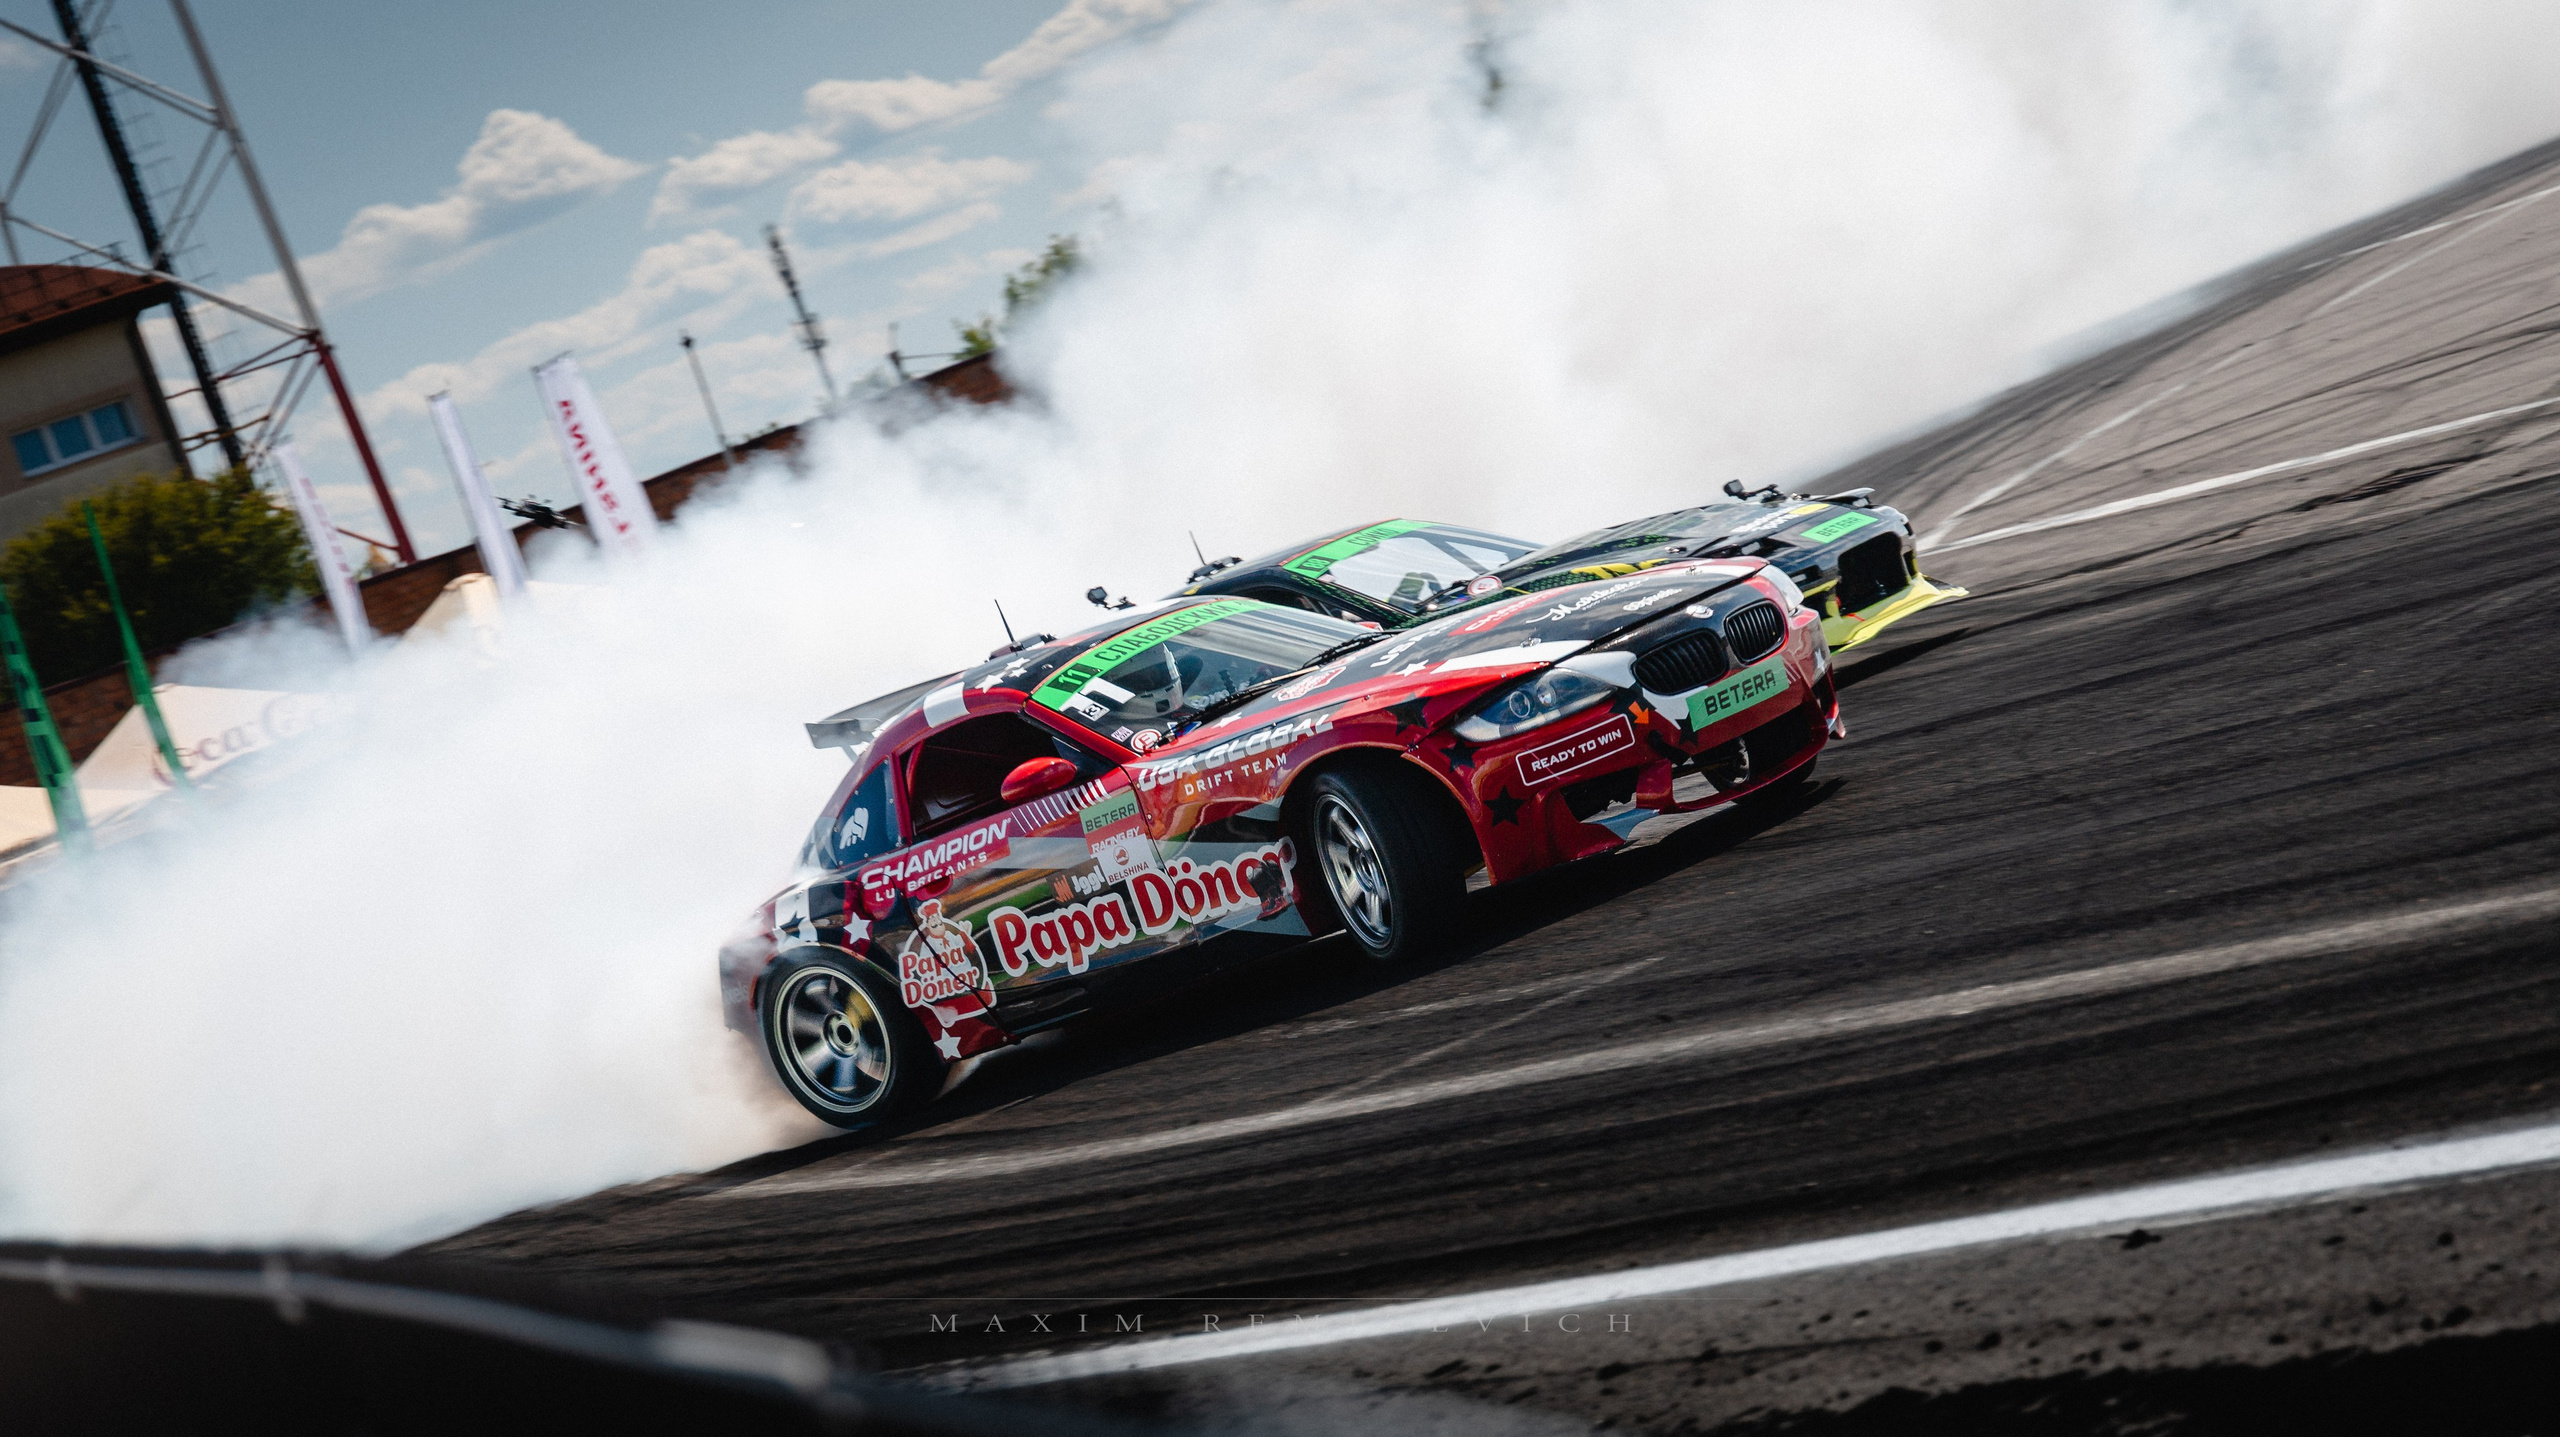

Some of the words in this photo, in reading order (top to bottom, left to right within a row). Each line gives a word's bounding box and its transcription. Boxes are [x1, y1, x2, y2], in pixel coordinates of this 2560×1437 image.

[1816, 517, 1863, 537] BETERA
[1059, 669, 1092, 685] 11
[1094, 602, 1238, 662] СЛАБОДСКИЙ
[1704, 668, 1776, 717] BETERA
[1138, 753, 1197, 792] USA
[1204, 713, 1334, 770] GLOBAL
[1532, 747, 1575, 772] READY
[1578, 738, 1597, 756] TO
[1597, 728, 1622, 749] WIN
[1184, 769, 1234, 797] DRIFT
[1241, 752, 1288, 778] TEAM
[1085, 802, 1136, 833] BETERA
[1126, 825, 1140, 840] BY
[861, 818, 1010, 891] CHAMPION
[1108, 861, 1150, 883] BELSHINA
[990, 898, 1133, 972] Papa
[902, 946, 965, 980] Papa
[904, 968, 978, 1006] Döner
